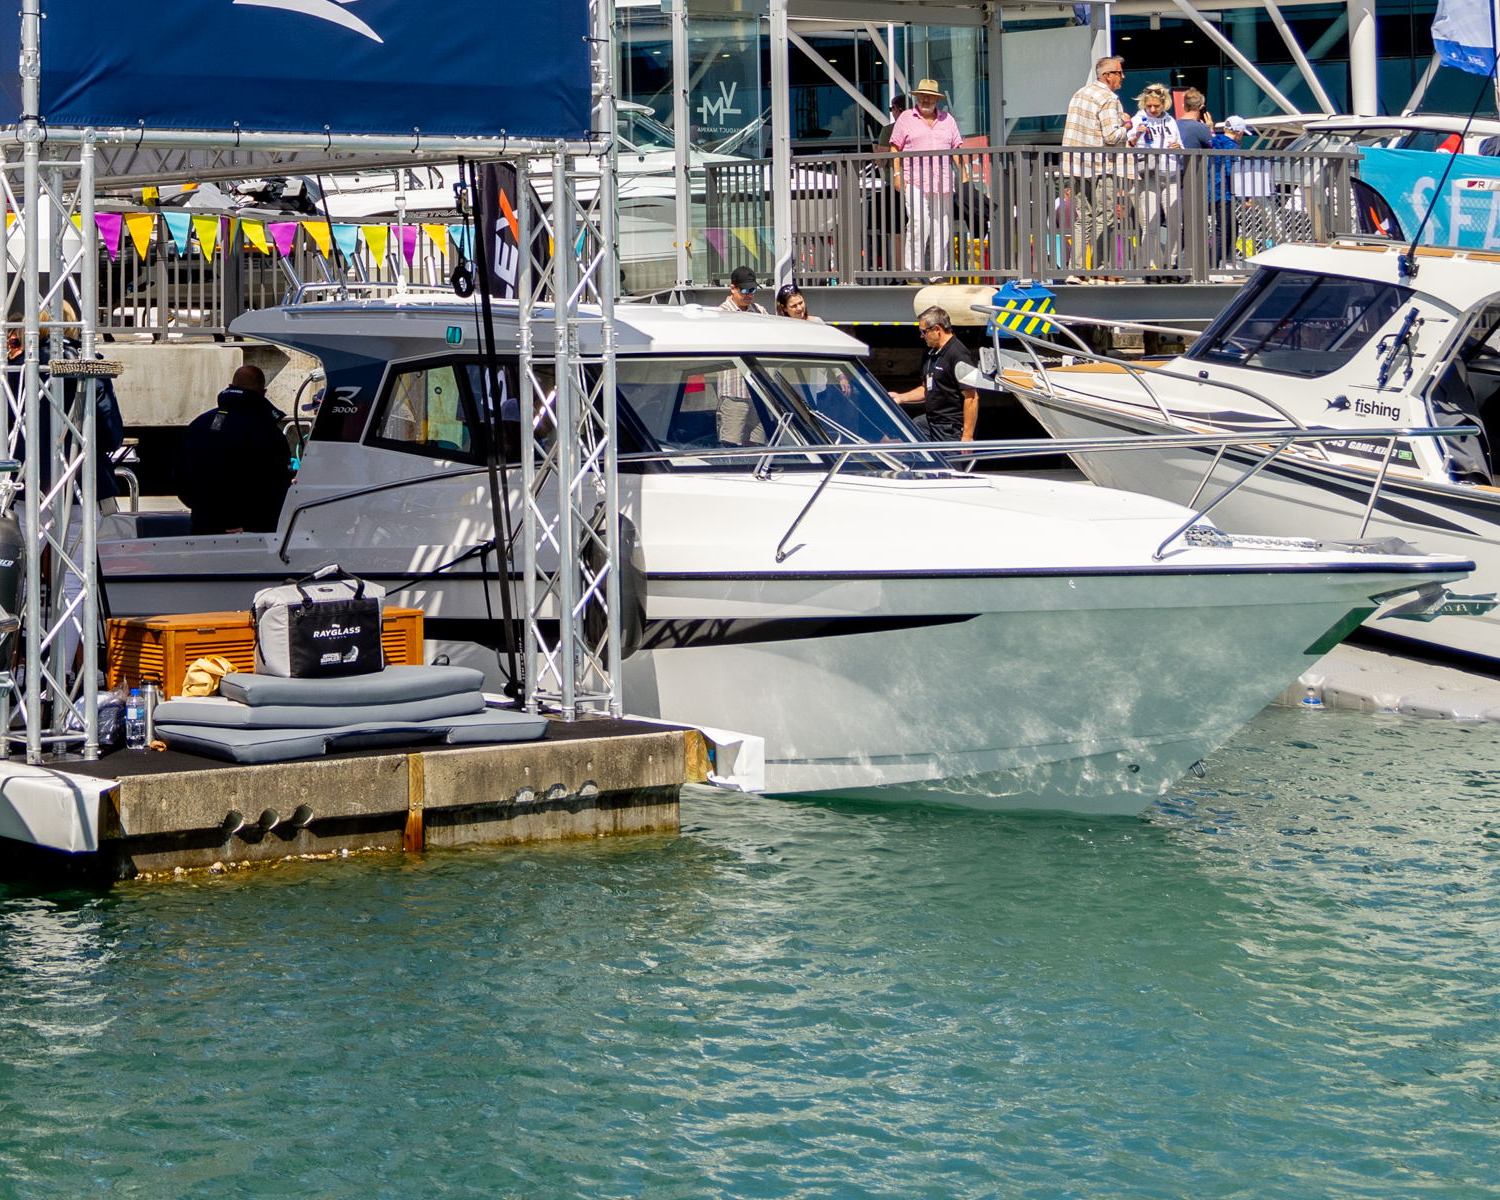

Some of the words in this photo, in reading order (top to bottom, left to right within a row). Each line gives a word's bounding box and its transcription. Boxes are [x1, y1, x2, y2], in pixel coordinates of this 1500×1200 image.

[332, 406, 358, 414] 3000
[1355, 399, 1401, 421] fishing
[1348, 441, 1374, 453] GAME
[313, 626, 361, 638] RAYGLASS
